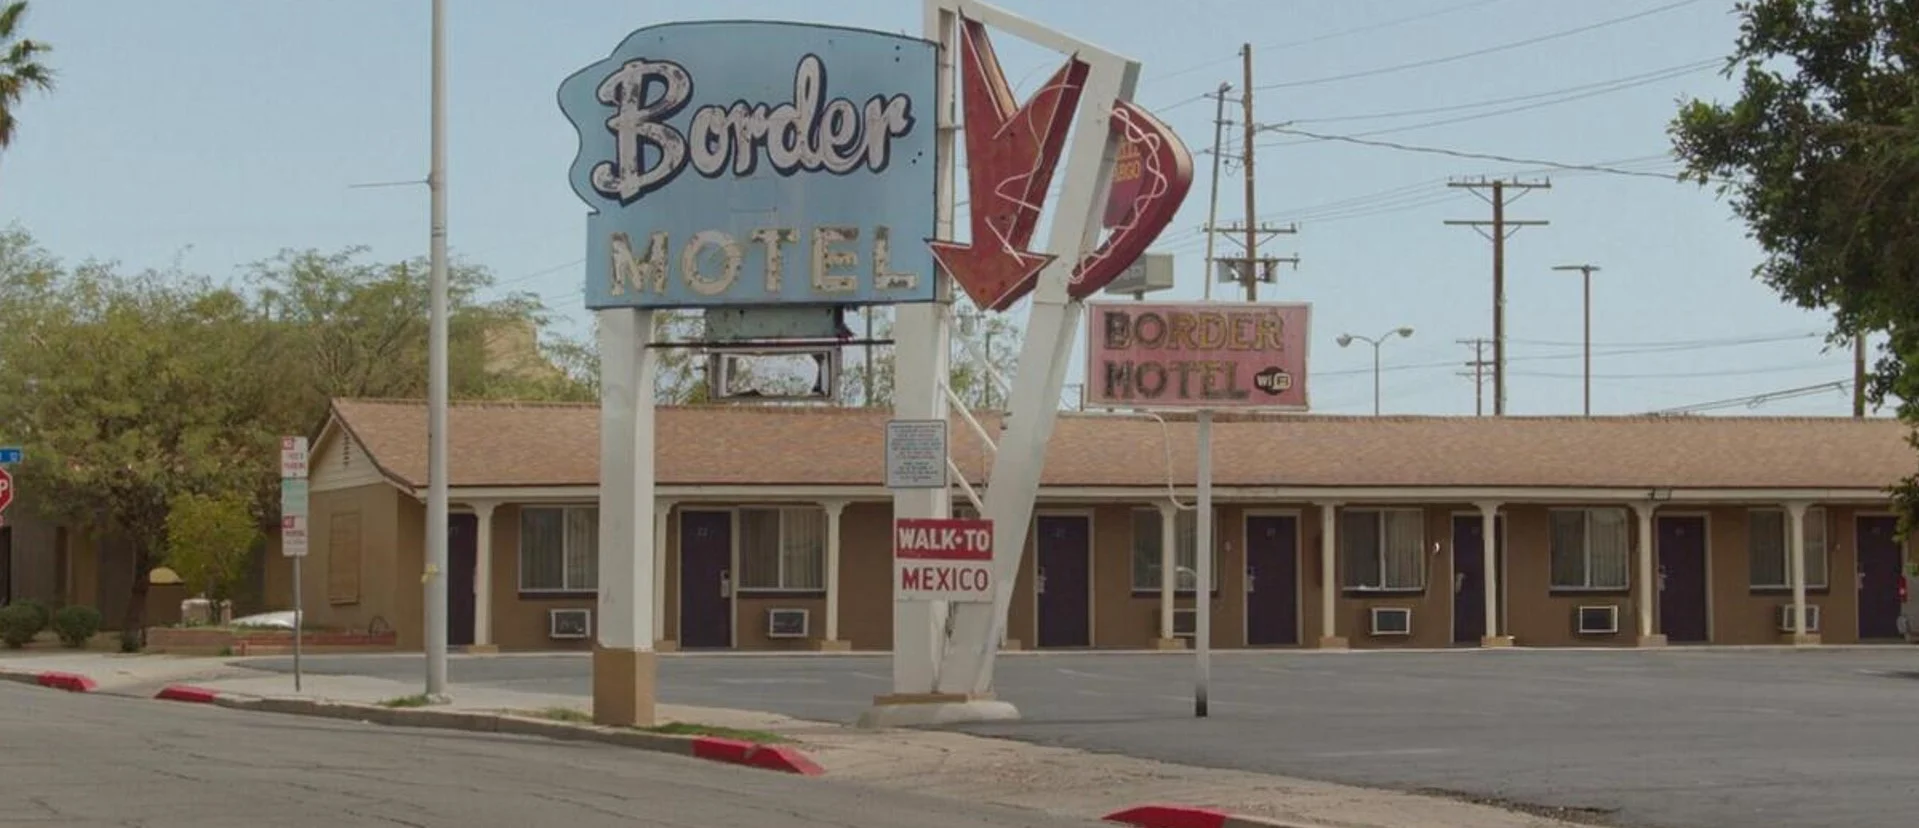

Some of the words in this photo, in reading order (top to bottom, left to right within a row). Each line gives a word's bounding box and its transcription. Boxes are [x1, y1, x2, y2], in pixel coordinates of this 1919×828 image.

[591, 53, 916, 207] Border
[610, 225, 919, 297] MOTEL
[1104, 311, 1285, 351] BORDER
[1104, 360, 1250, 399] MOTEL
[902, 566, 988, 592] MEXICO
